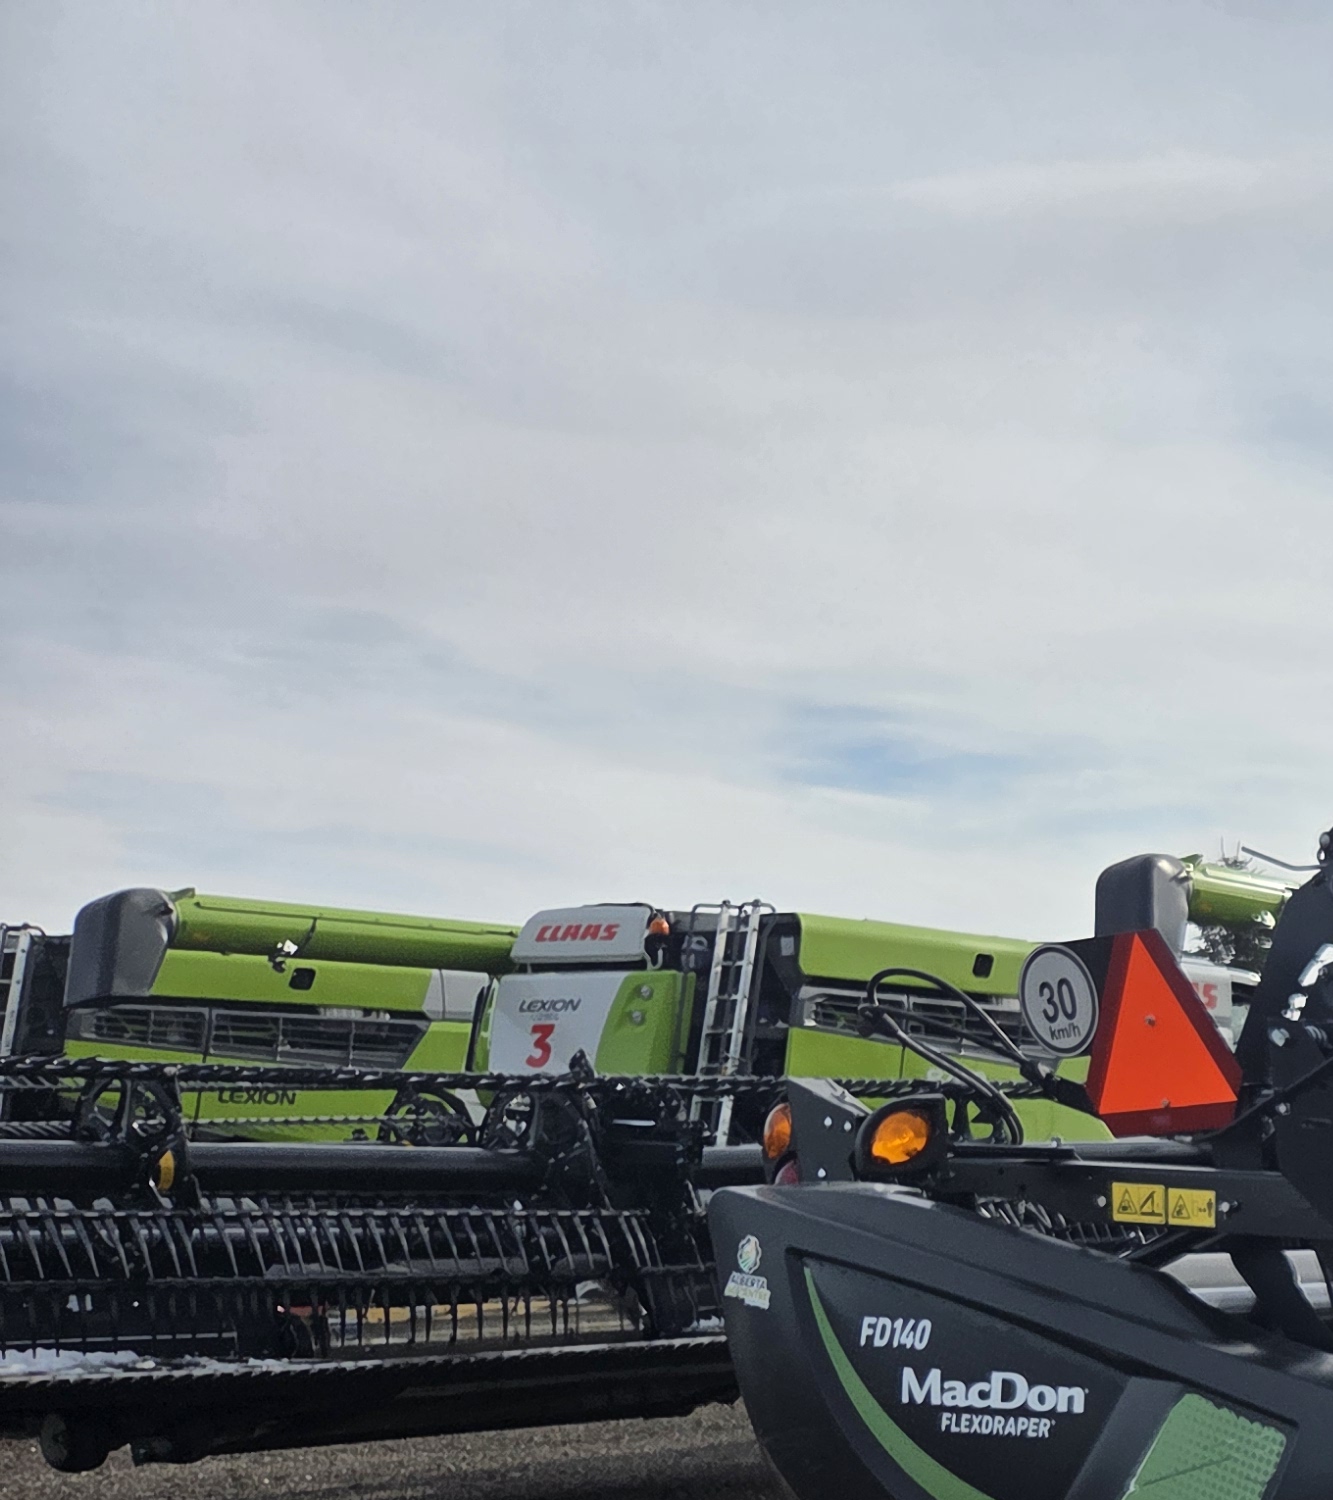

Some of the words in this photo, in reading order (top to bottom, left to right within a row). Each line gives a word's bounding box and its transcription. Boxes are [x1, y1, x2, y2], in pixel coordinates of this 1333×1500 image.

[535, 923, 620, 943] CLAAS
[518, 998, 582, 1013] LEXION
[1039, 977, 1077, 1024] 30
[1049, 1022, 1081, 1040] km/h
[525, 1023, 555, 1068] 3
[217, 1086, 297, 1105] LEXION
[860, 1316, 932, 1350] FD140
[901, 1366, 1086, 1414] MacDon
[941, 1412, 1050, 1438] FLEXDRAPER
